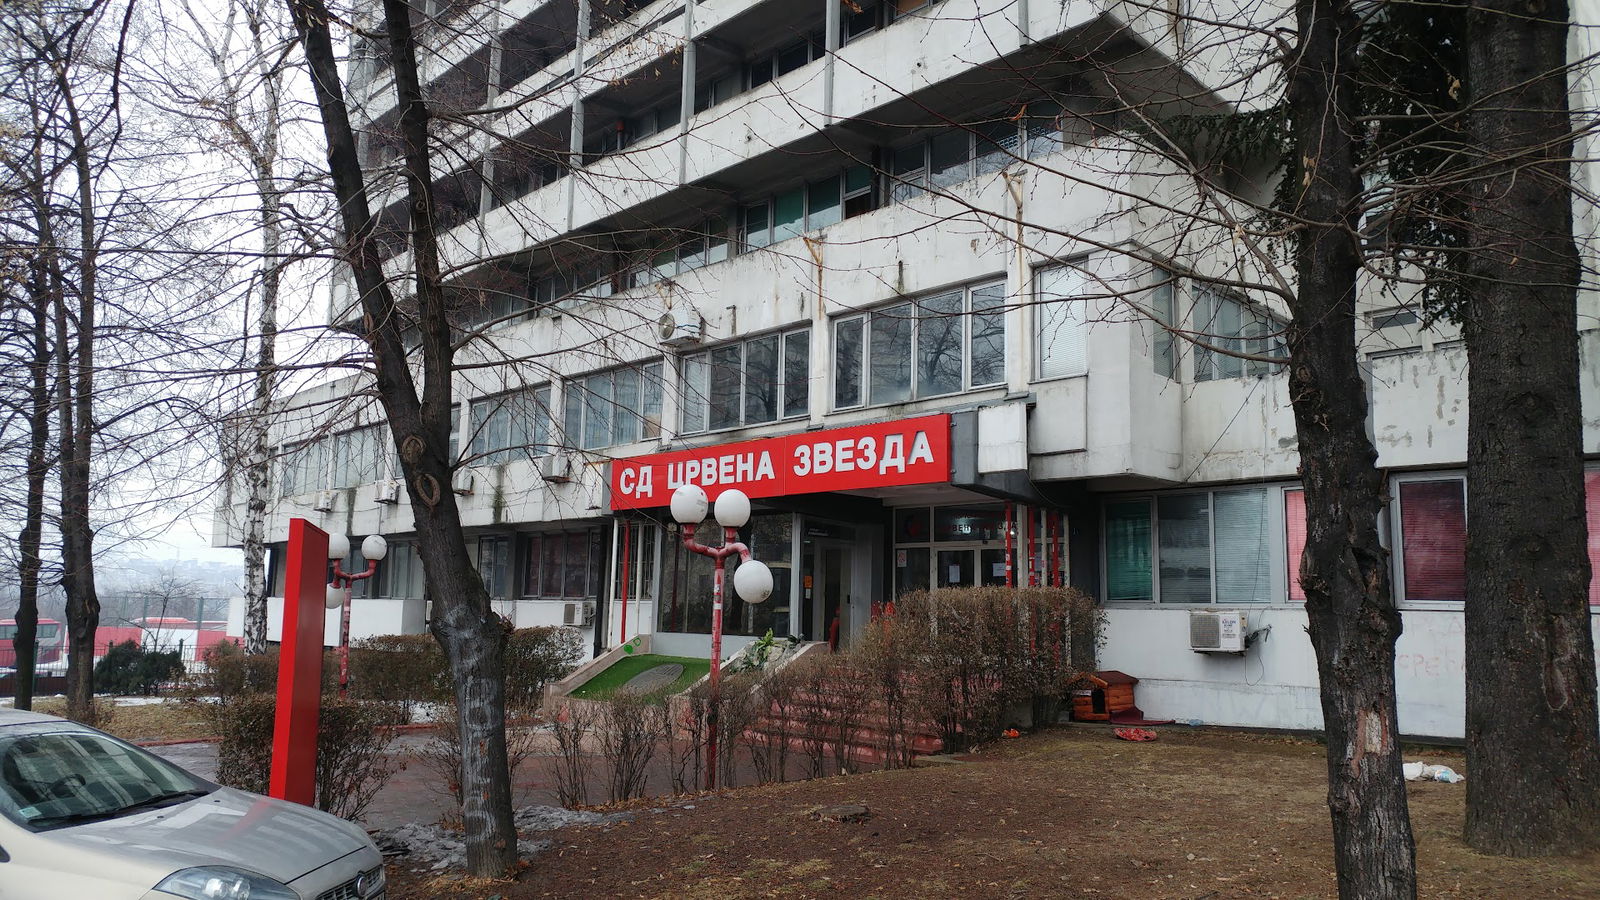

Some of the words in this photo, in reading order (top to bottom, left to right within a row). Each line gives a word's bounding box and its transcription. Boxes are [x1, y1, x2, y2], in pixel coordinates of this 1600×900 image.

[619, 466, 653, 499] СД
[667, 450, 775, 490] ЦРВЕНА
[793, 430, 934, 477] ЗВЕЗДА
